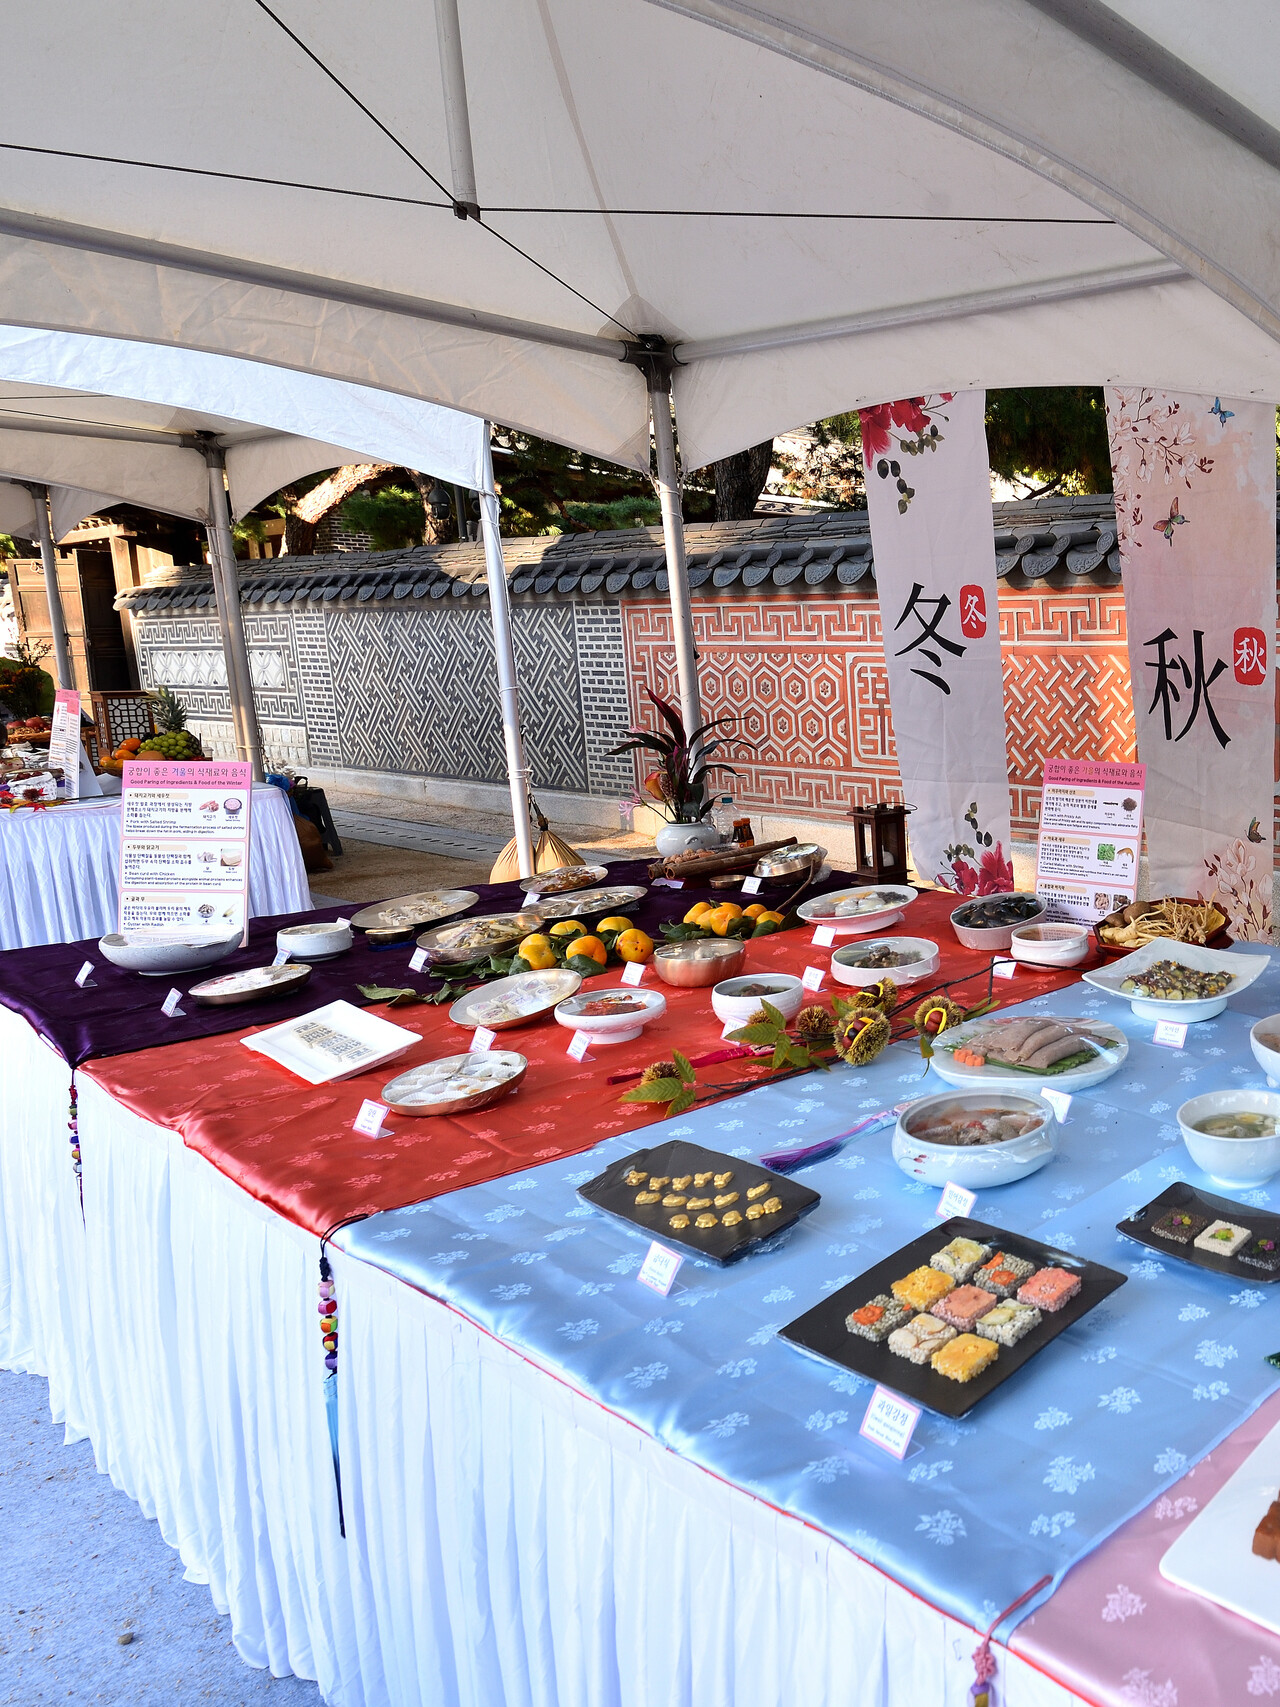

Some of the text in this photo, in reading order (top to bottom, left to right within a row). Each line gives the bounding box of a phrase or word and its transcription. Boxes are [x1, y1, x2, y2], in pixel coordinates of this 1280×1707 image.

[963, 593, 987, 630] 冬
[894, 581, 968, 695] 冬
[1234, 637, 1267, 676] 秋
[1143, 627, 1232, 749] 秋
[127, 766, 246, 778] 궁합이 좋은 겨울의 식재료와 음식
[1048, 763, 1142, 778] 궁합이 좋은 가을의 식재료와 음식
[877, 1399, 909, 1427] 과일강정
